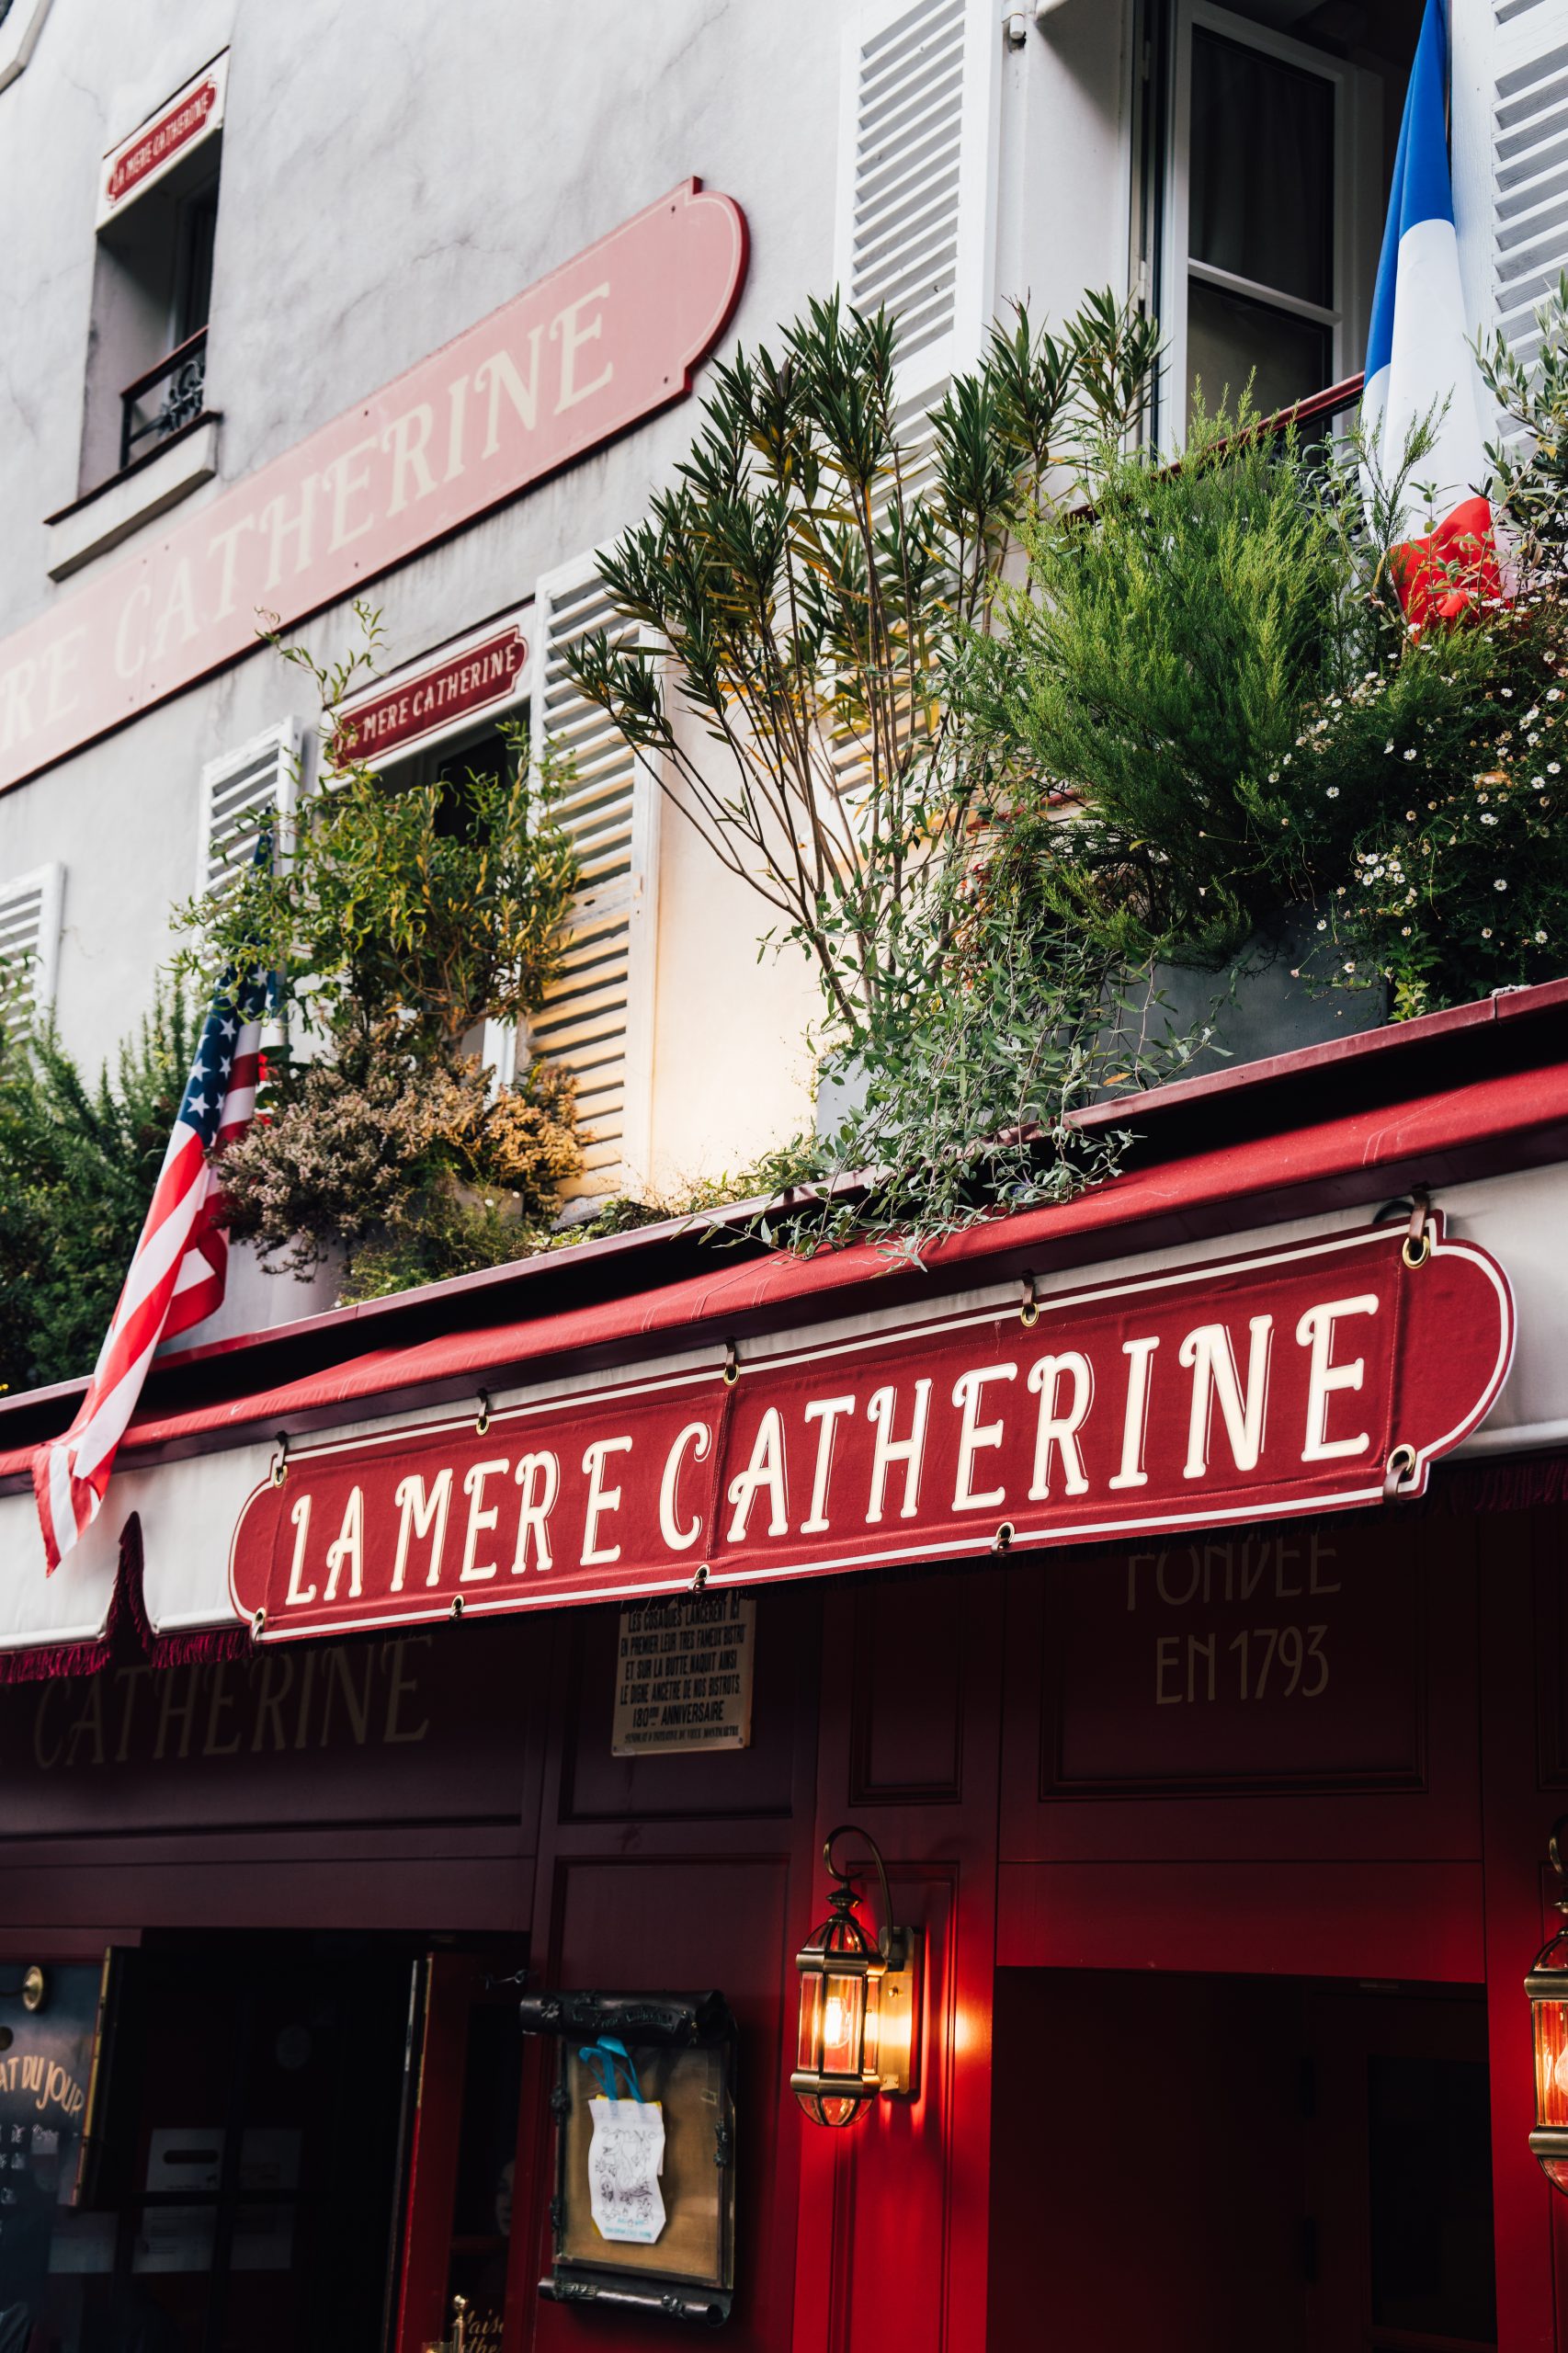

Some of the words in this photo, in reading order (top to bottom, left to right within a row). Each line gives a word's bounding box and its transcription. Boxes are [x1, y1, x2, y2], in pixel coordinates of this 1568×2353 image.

[153, 91, 210, 156] CATHERINE
[112, 281, 615, 681] CATHERINE
[363, 697, 410, 743] MERE
[413, 643, 516, 717] CATHERINE
[286, 1484, 364, 1606] LA
[390, 1435, 633, 1592] MERE
[658, 1293, 1380, 1551] CATHERINE
[33, 1633, 434, 1770] CATHERINE
[1155, 1631, 1216, 1705] EN
[1228, 1624, 1330, 1701] 1793
[660, 1699, 725, 1726] ANNIVERSAIRE
[21, 2055, 44, 2092] DU
[36, 2061, 85, 2120] JOUR
